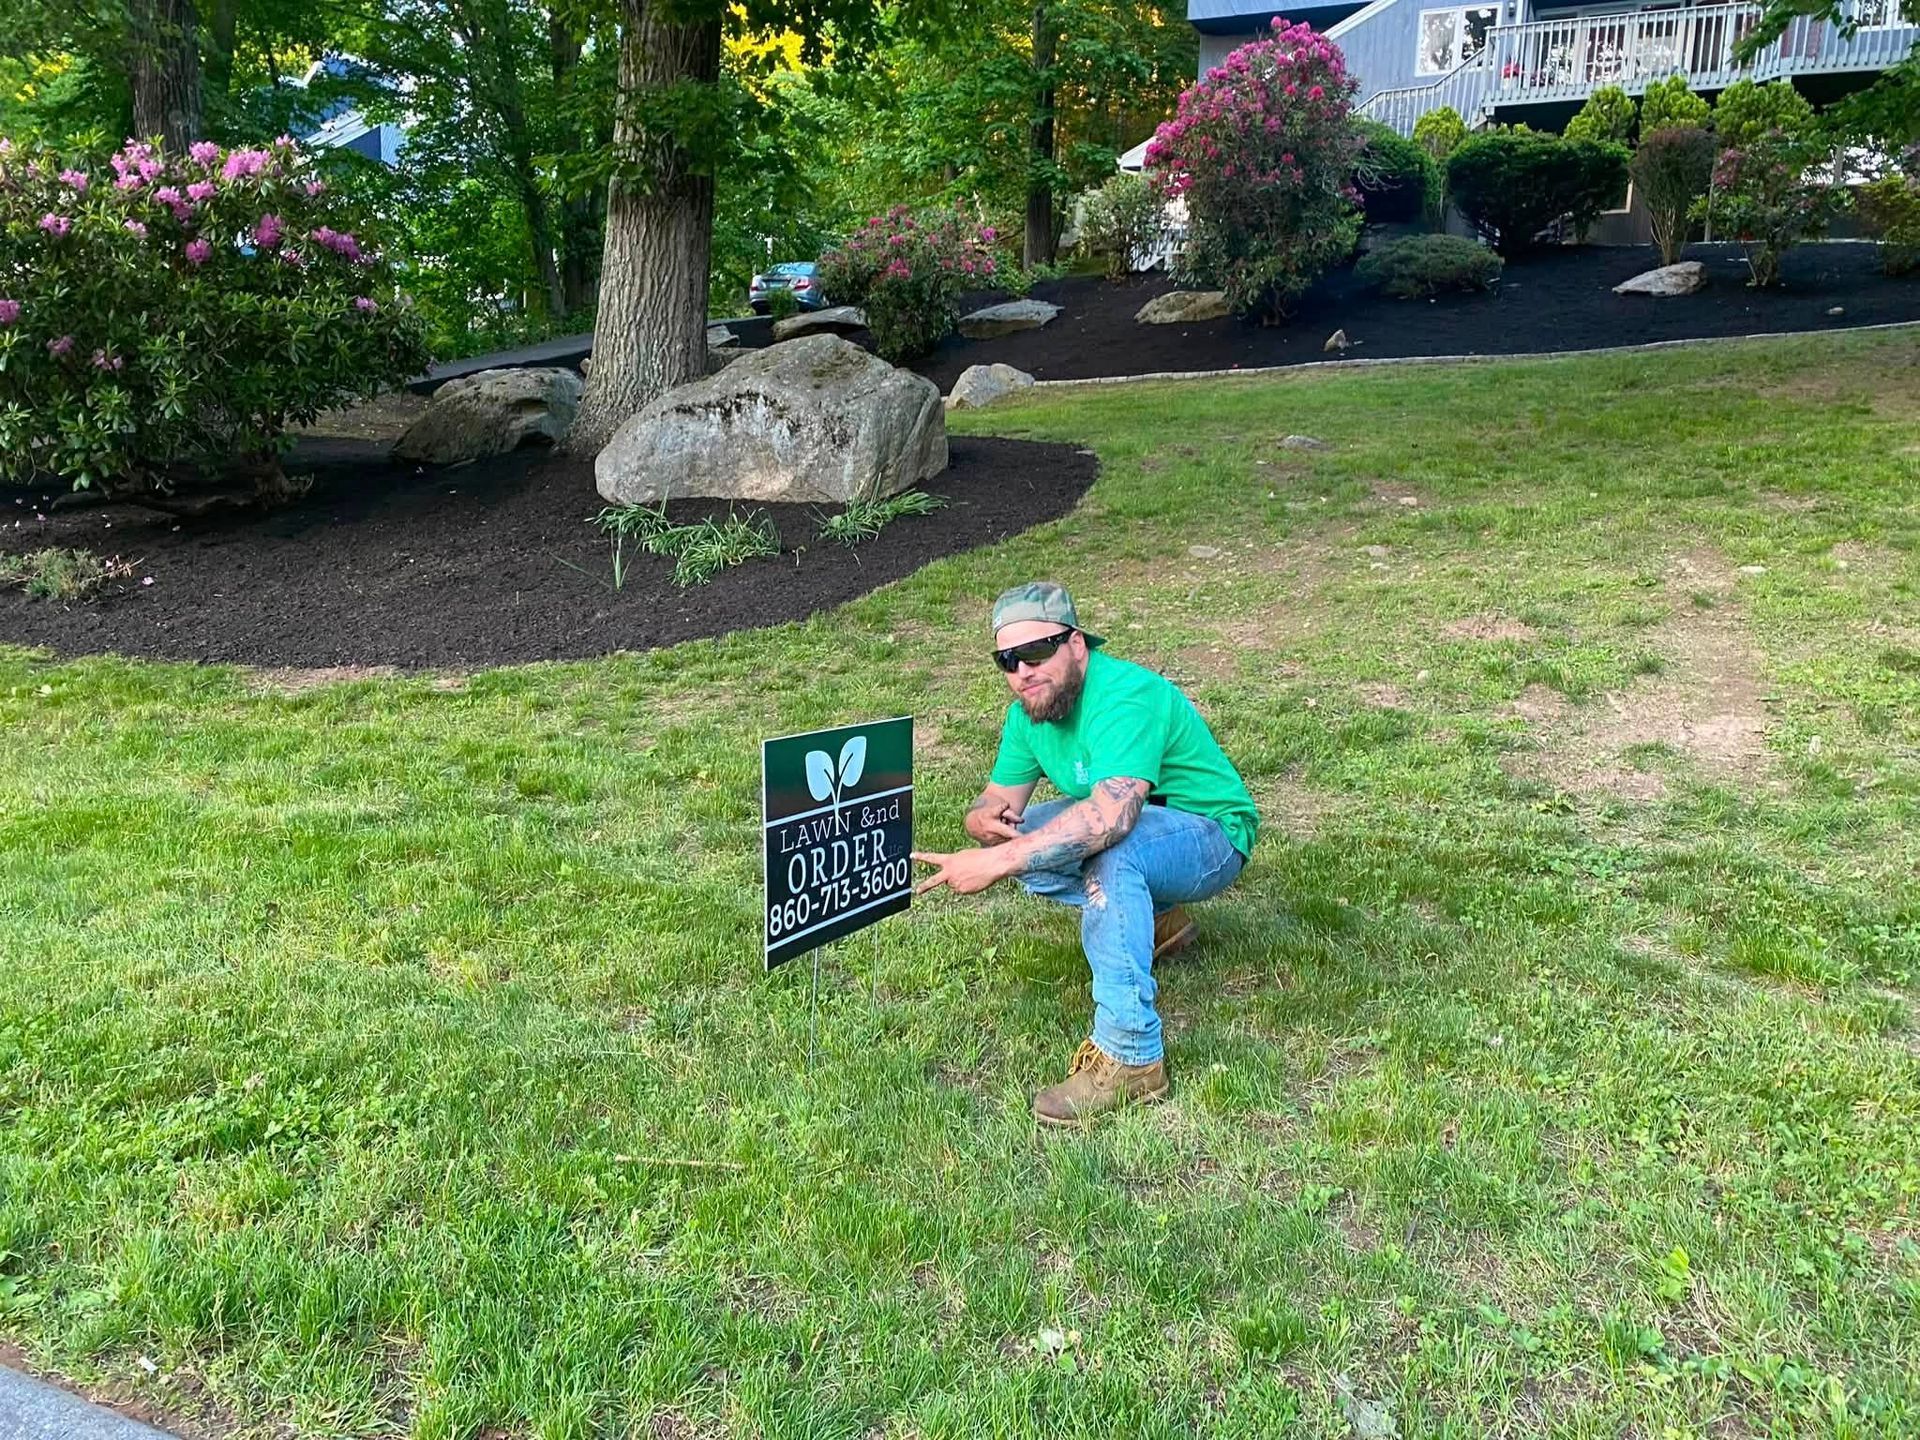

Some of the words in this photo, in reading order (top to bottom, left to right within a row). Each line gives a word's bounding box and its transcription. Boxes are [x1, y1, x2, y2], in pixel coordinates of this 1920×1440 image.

[780, 811, 851, 853] LAWN
[860, 799, 899, 828] &nd
[788, 828, 887, 894] ORDER
[769, 858, 908, 936] 860-713-3600
